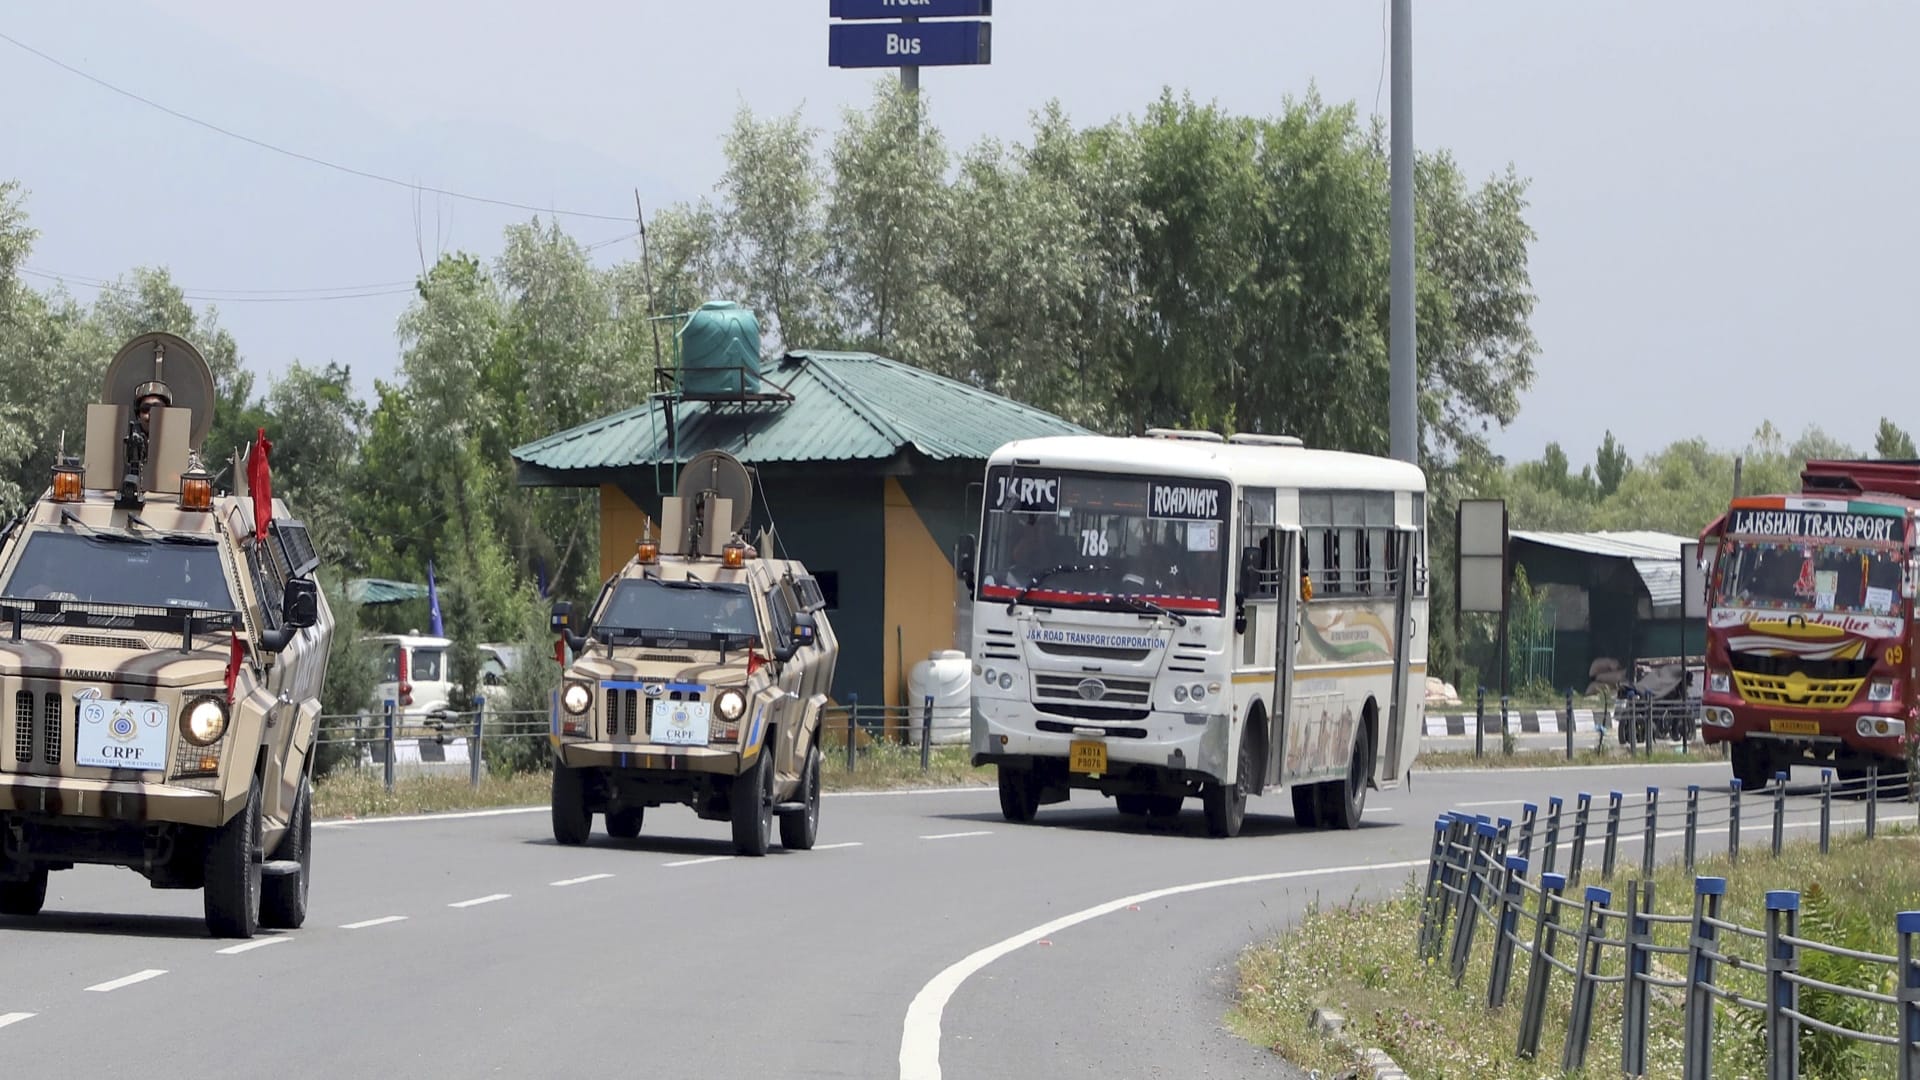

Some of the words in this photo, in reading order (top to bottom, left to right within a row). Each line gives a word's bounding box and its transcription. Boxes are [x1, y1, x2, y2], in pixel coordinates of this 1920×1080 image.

[886, 33, 921, 55] Bus
[1154, 486, 1218, 518] ROADWAYS
[1735, 511, 1800, 534] LAKSHMI
[1803, 513, 1895, 540] TRANSPORT
[1081, 529, 1109, 557] 786
[1026, 629, 1041, 640] J&K
[1043, 630, 1064, 641] ROAD
[1885, 645, 1903, 667] 09
[65, 668, 115, 680] MARKSMAN
[87, 708, 101, 719] 75
[150, 711, 156, 723] 1
[666, 729, 694, 739] CRPF
[101, 745, 144, 759] CRPF
